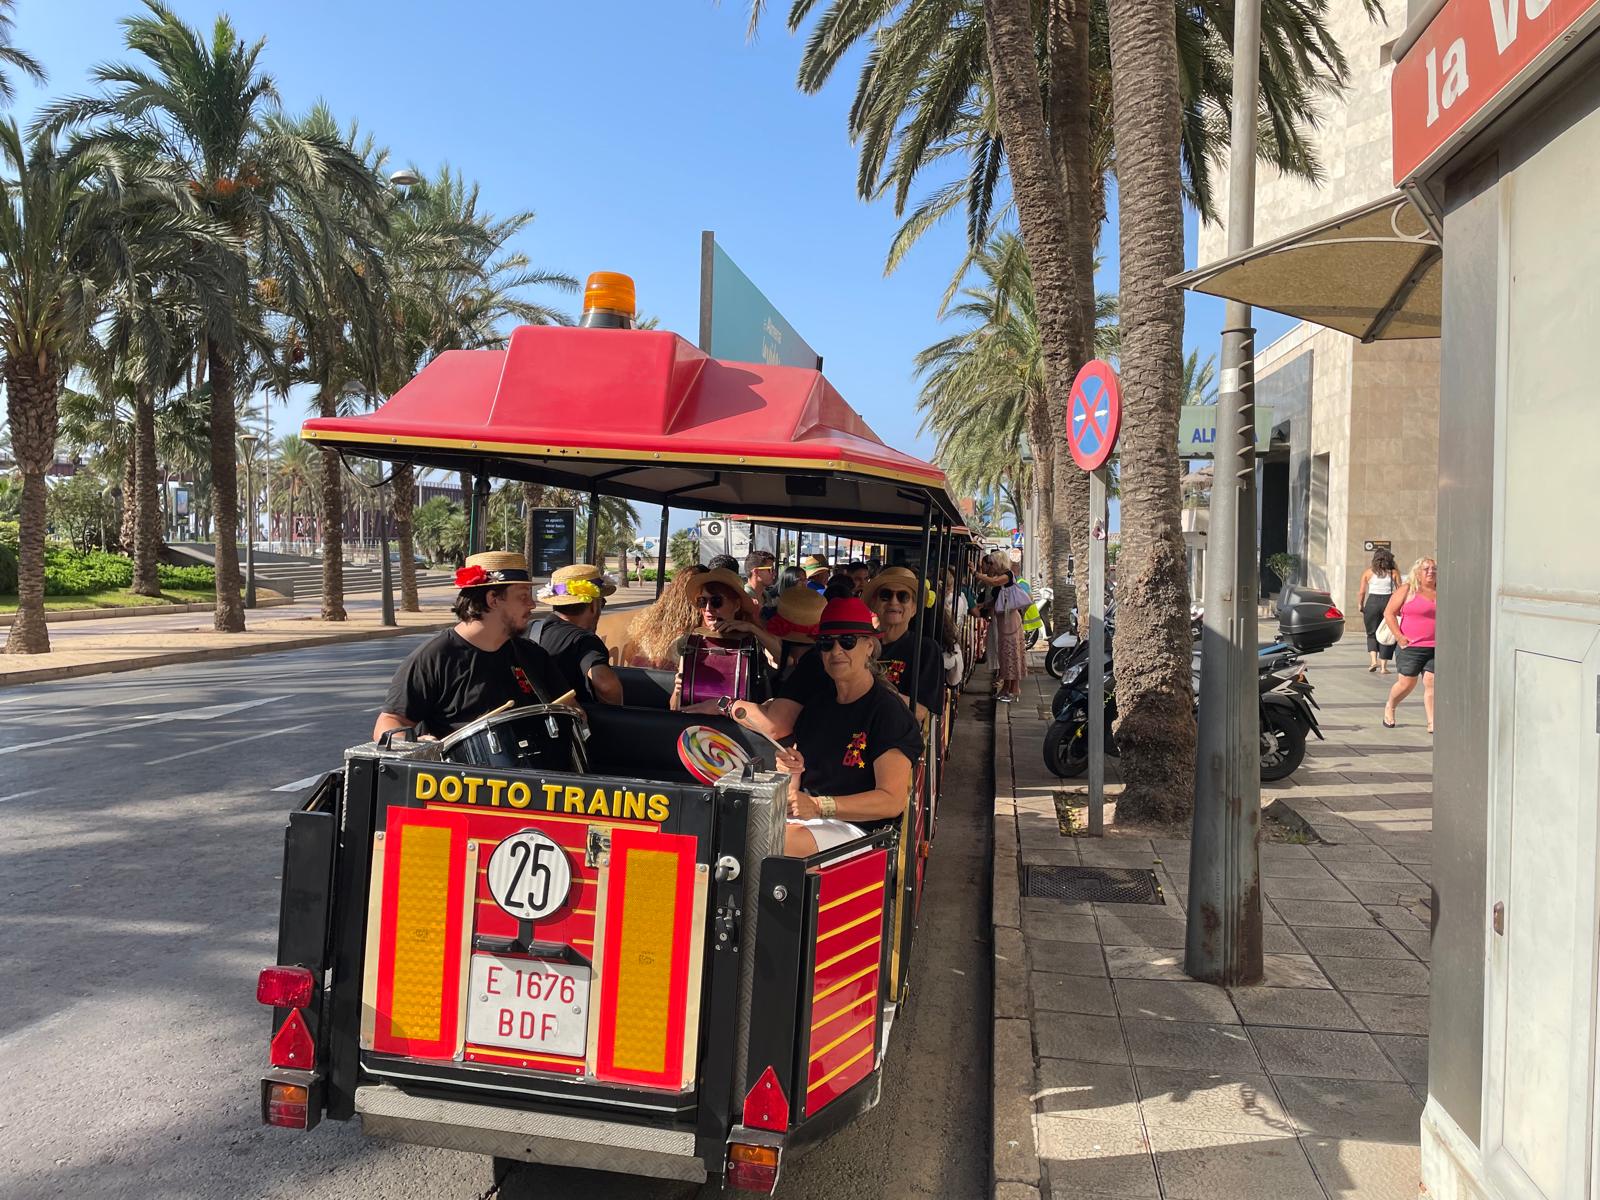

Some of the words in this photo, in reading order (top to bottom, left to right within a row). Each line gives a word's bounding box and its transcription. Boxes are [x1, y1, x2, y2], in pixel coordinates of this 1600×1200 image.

[1425, 36, 1470, 128] la
[1488, 0, 1554, 56] V
[415, 772, 532, 809] DOTTO
[541, 784, 670, 822] TRAINS
[504, 840, 555, 912] 25
[486, 965, 503, 995] E
[515, 969, 576, 1004] 1676
[498, 1008, 557, 1042] BDF
